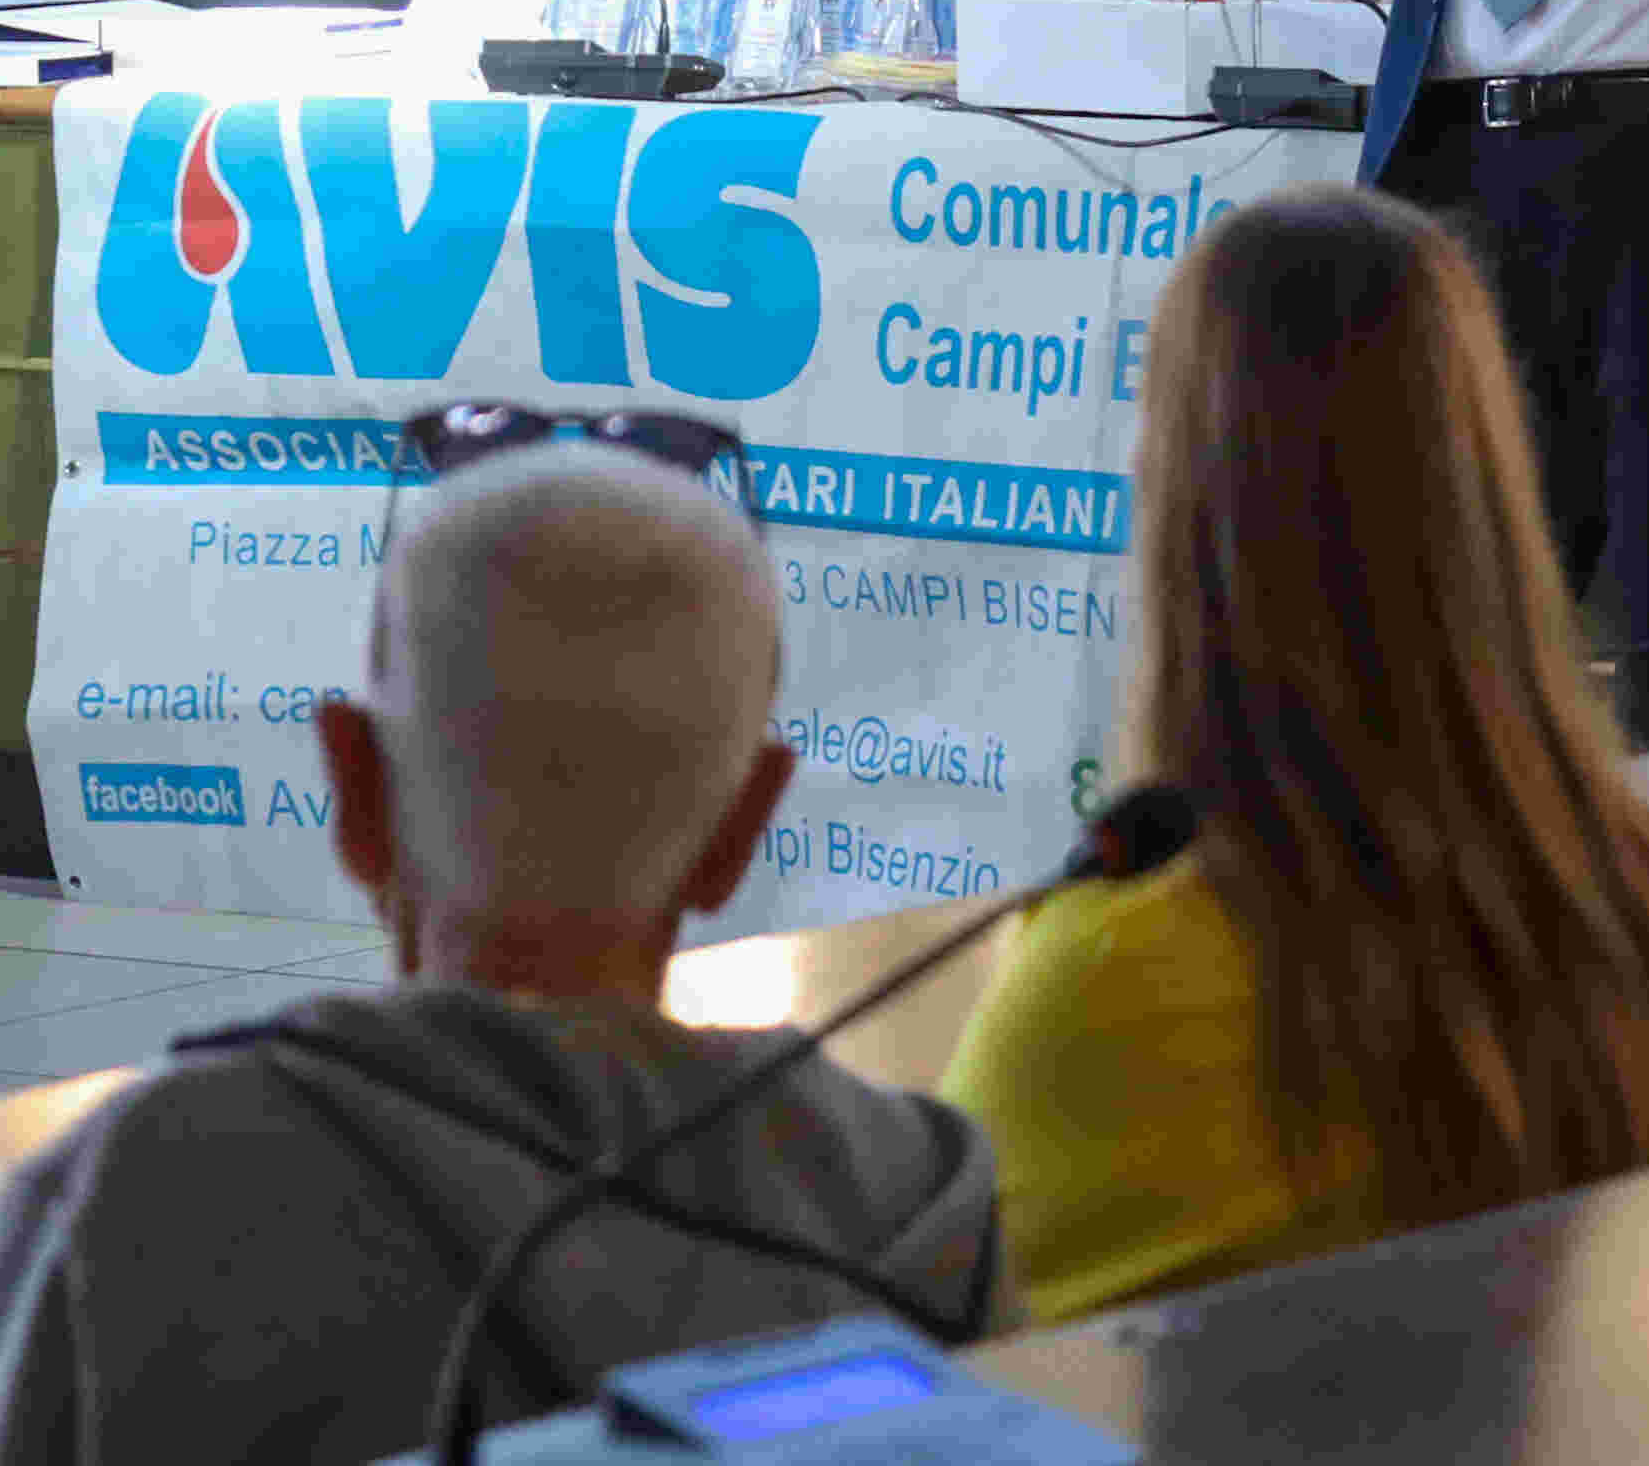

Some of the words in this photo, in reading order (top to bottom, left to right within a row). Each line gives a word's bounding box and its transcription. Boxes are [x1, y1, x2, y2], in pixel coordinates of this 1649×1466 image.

[95, 91, 823, 401] AVIS
[876, 301, 1089, 418] Campi
[705, 456, 856, 517] NTARI
[881, 471, 1119, 540] ITALIANI
[189, 520, 341, 568] Piazza
[821, 563, 968, 622] CAMPI
[77, 671, 240, 723] e-mail:
[87, 774, 239, 815] facebook
